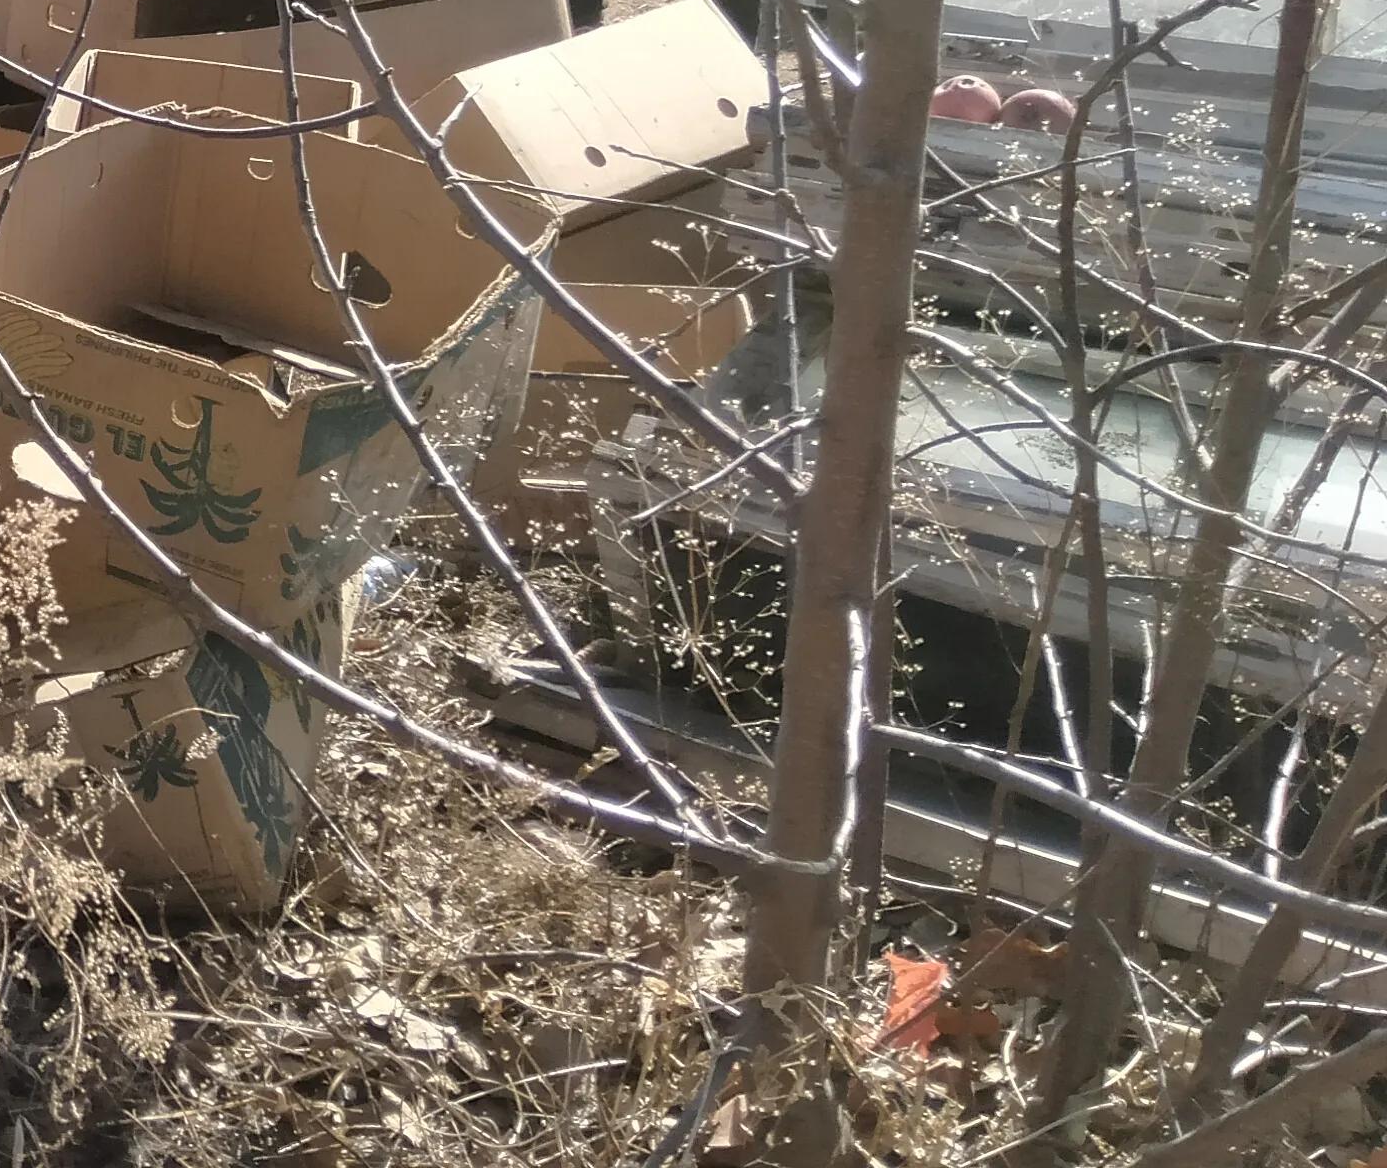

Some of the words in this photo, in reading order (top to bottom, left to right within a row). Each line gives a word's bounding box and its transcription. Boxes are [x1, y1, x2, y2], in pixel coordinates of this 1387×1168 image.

[75, 332, 151, 365] PHILIPPINES
[97, 405, 145, 426] FRESH
[106, 422, 147, 463] EL
